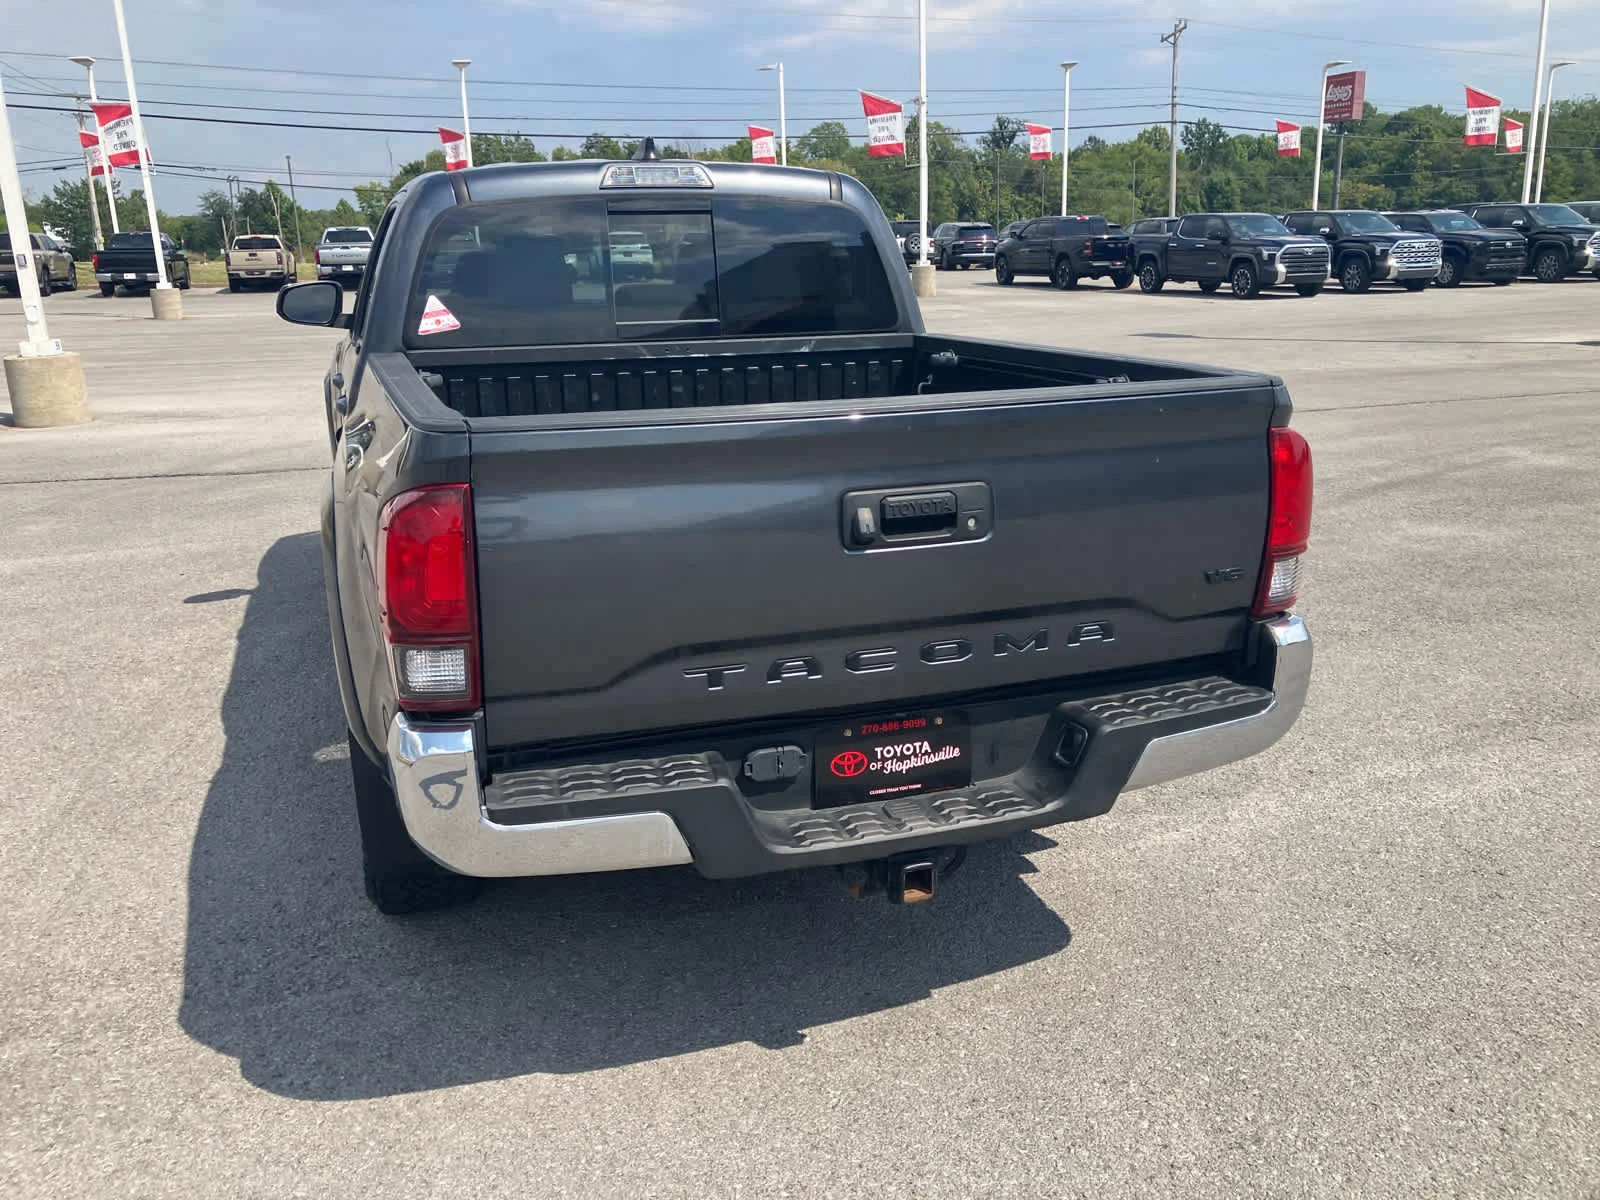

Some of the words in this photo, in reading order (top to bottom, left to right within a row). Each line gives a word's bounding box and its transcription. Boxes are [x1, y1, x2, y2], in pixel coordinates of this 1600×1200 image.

[888, 498, 953, 517] TOYOTA
[683, 620, 1115, 691] TACOMA
[869, 761, 883, 771] OF
[883, 745, 961, 774] Hopkinsville
[874, 741, 932, 760] TOYOTA
